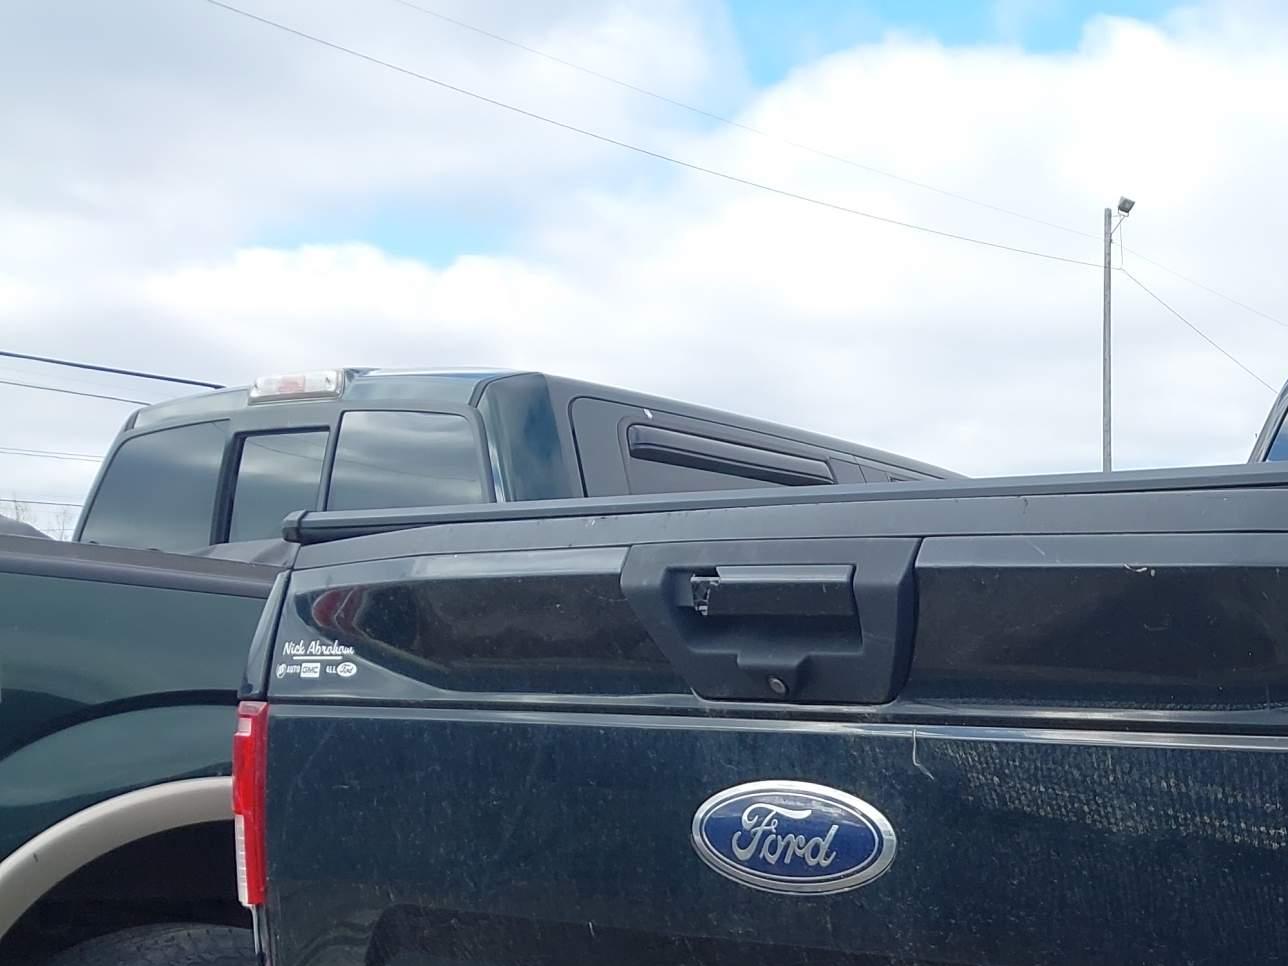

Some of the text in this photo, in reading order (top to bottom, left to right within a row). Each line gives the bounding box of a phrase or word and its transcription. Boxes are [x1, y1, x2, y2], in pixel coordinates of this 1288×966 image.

[282, 639, 354, 656] Nick Abraham
[731, 803, 840, 868] Ford
